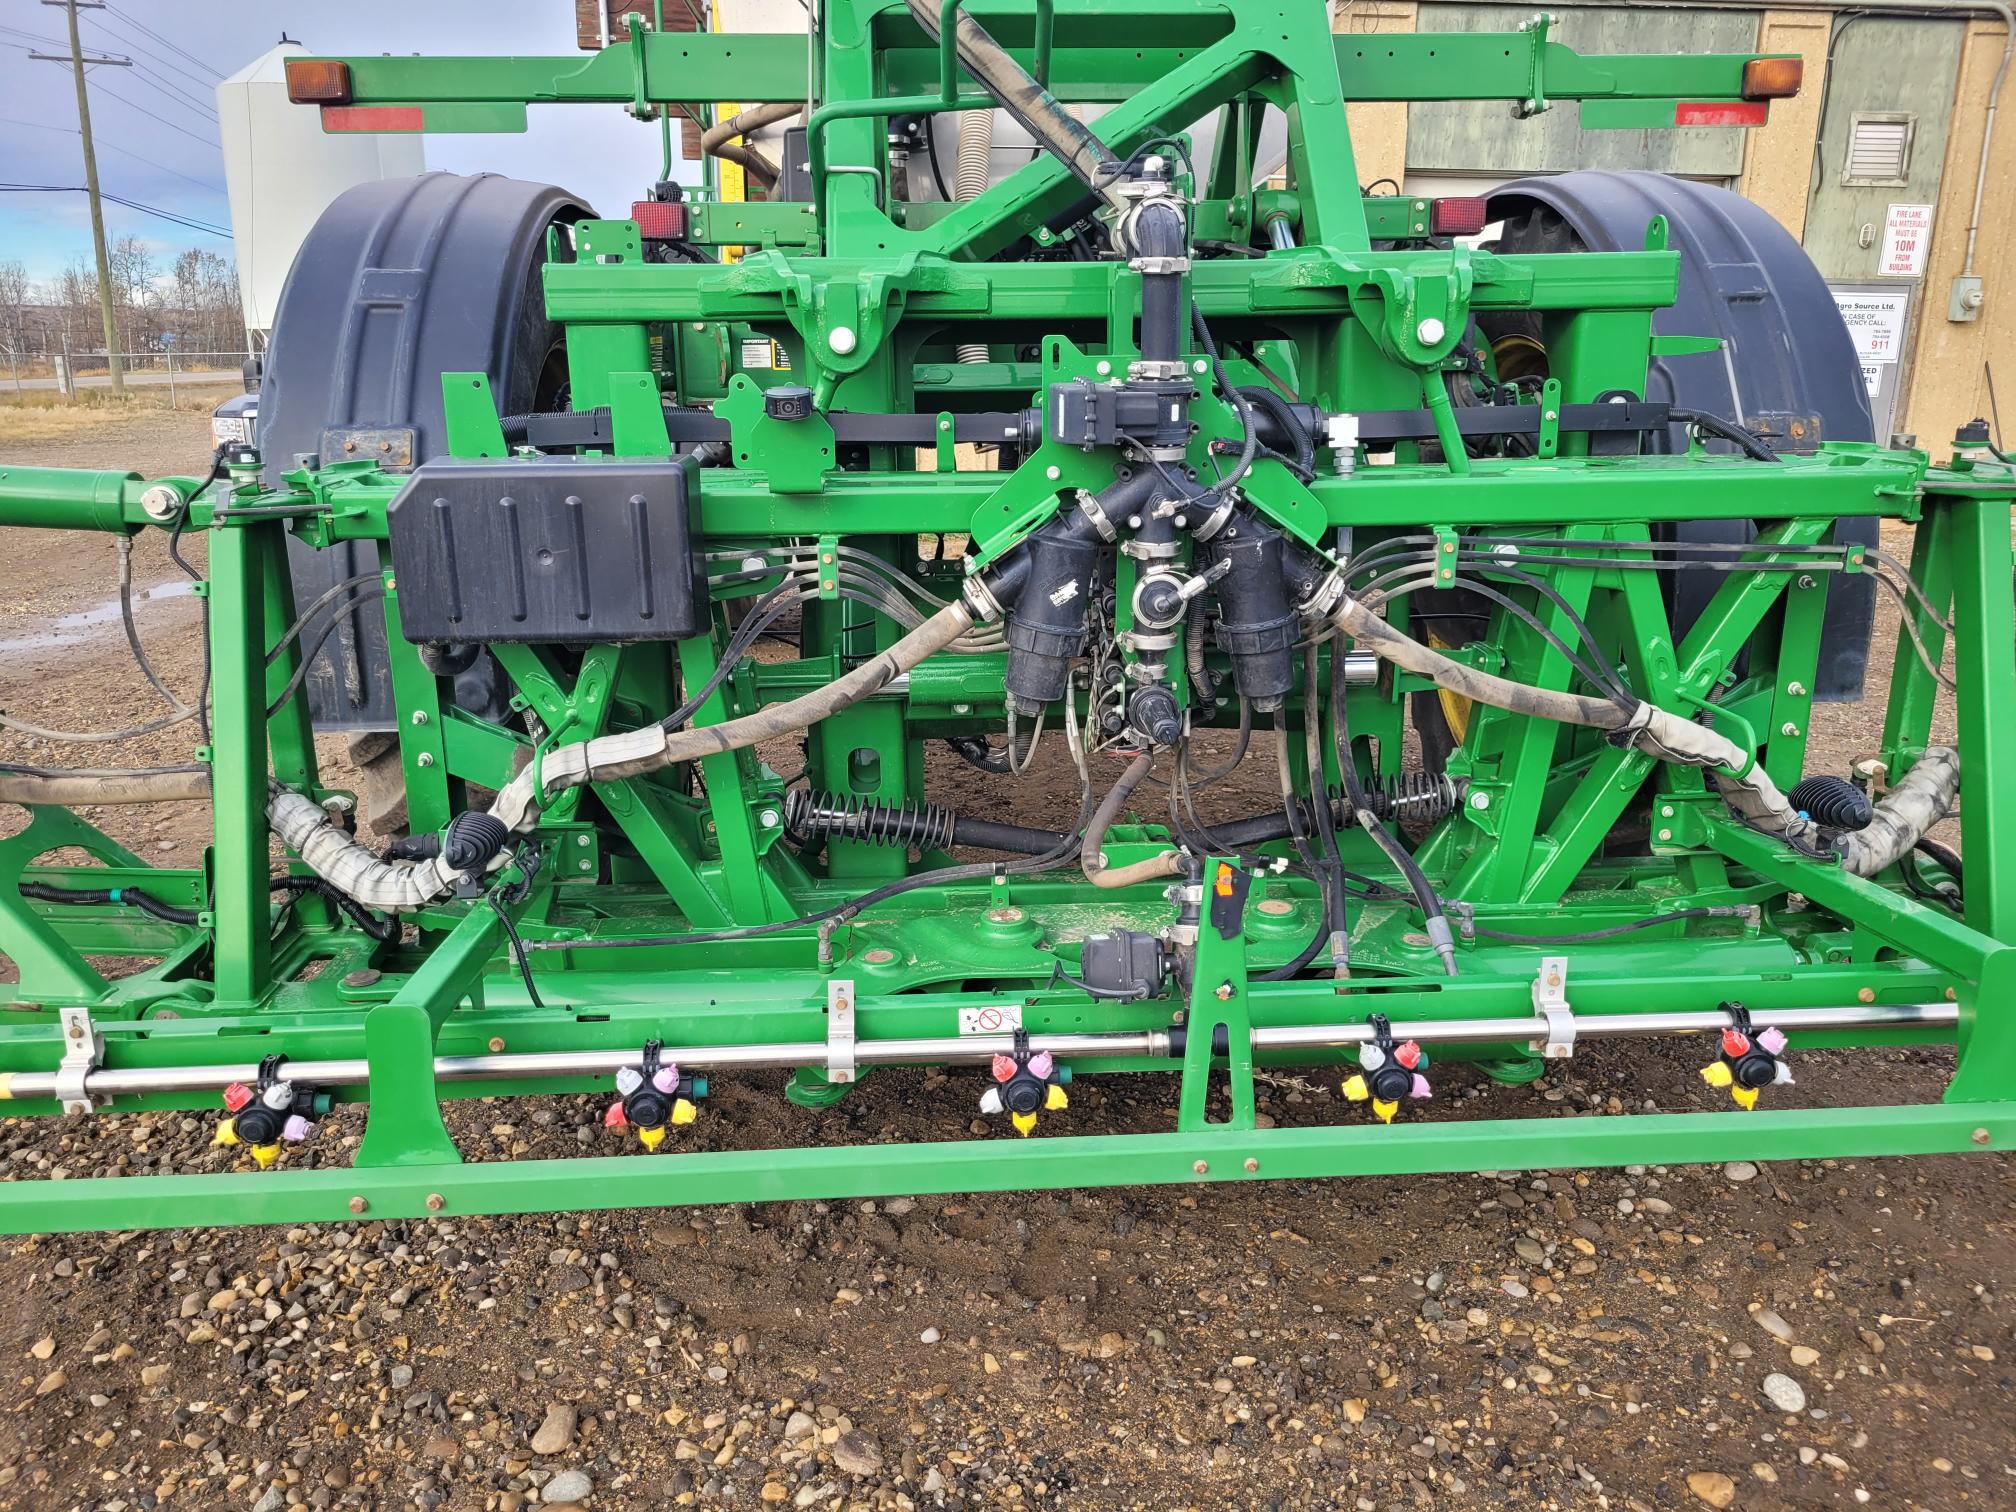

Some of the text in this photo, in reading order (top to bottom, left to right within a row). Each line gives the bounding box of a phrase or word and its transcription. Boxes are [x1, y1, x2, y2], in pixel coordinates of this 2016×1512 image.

[1899, 220, 1927, 228] MATERIALS
[1895, 240, 1915, 252] 10M
[1871, 340, 1889, 350] 911
